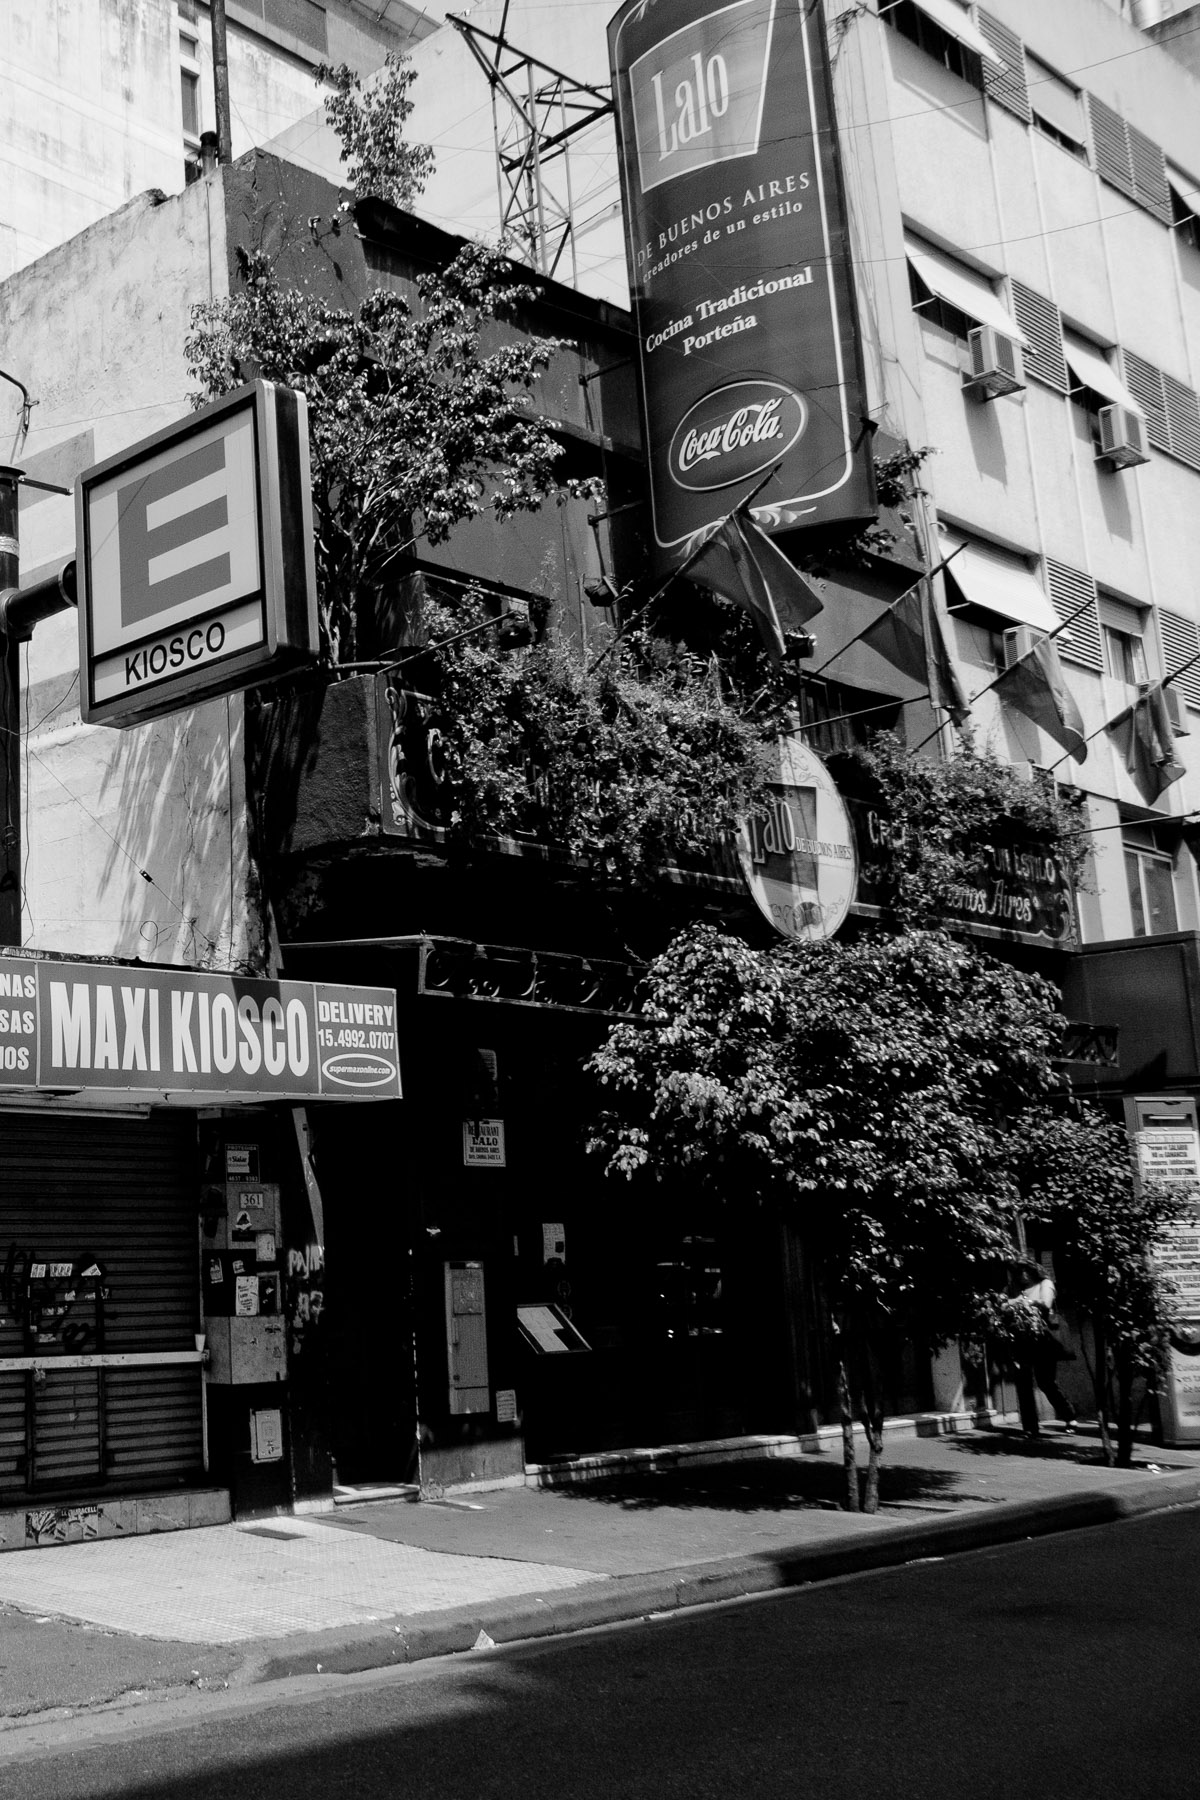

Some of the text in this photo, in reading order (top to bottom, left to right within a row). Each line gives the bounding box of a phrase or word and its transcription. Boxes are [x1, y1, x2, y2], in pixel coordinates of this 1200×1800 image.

[651, 52, 729, 161] Lalo
[637, 172, 811, 267] DE BUENOS AIRES
[642, 201, 803, 284] creadores de un estilo
[646, 266, 814, 353] Cocina Tradicional
[683, 315, 758, 356] Porteña
[679, 397, 782, 471] Coca-Cola
[117, 436, 231, 628] E
[125, 622, 226, 685] KIOSCO
[795, 836, 807, 853] DE
[50, 981, 310, 1077] MAXI KIOSCO
[318, 1029, 395, 1049] 15.4992.0707
[319, 1001, 393, 1026] DELIVERY
[467, 1125, 499, 1137] REAURANT
[472, 1137, 498, 1146] LALO
[244, 1194, 261, 1206] 361
